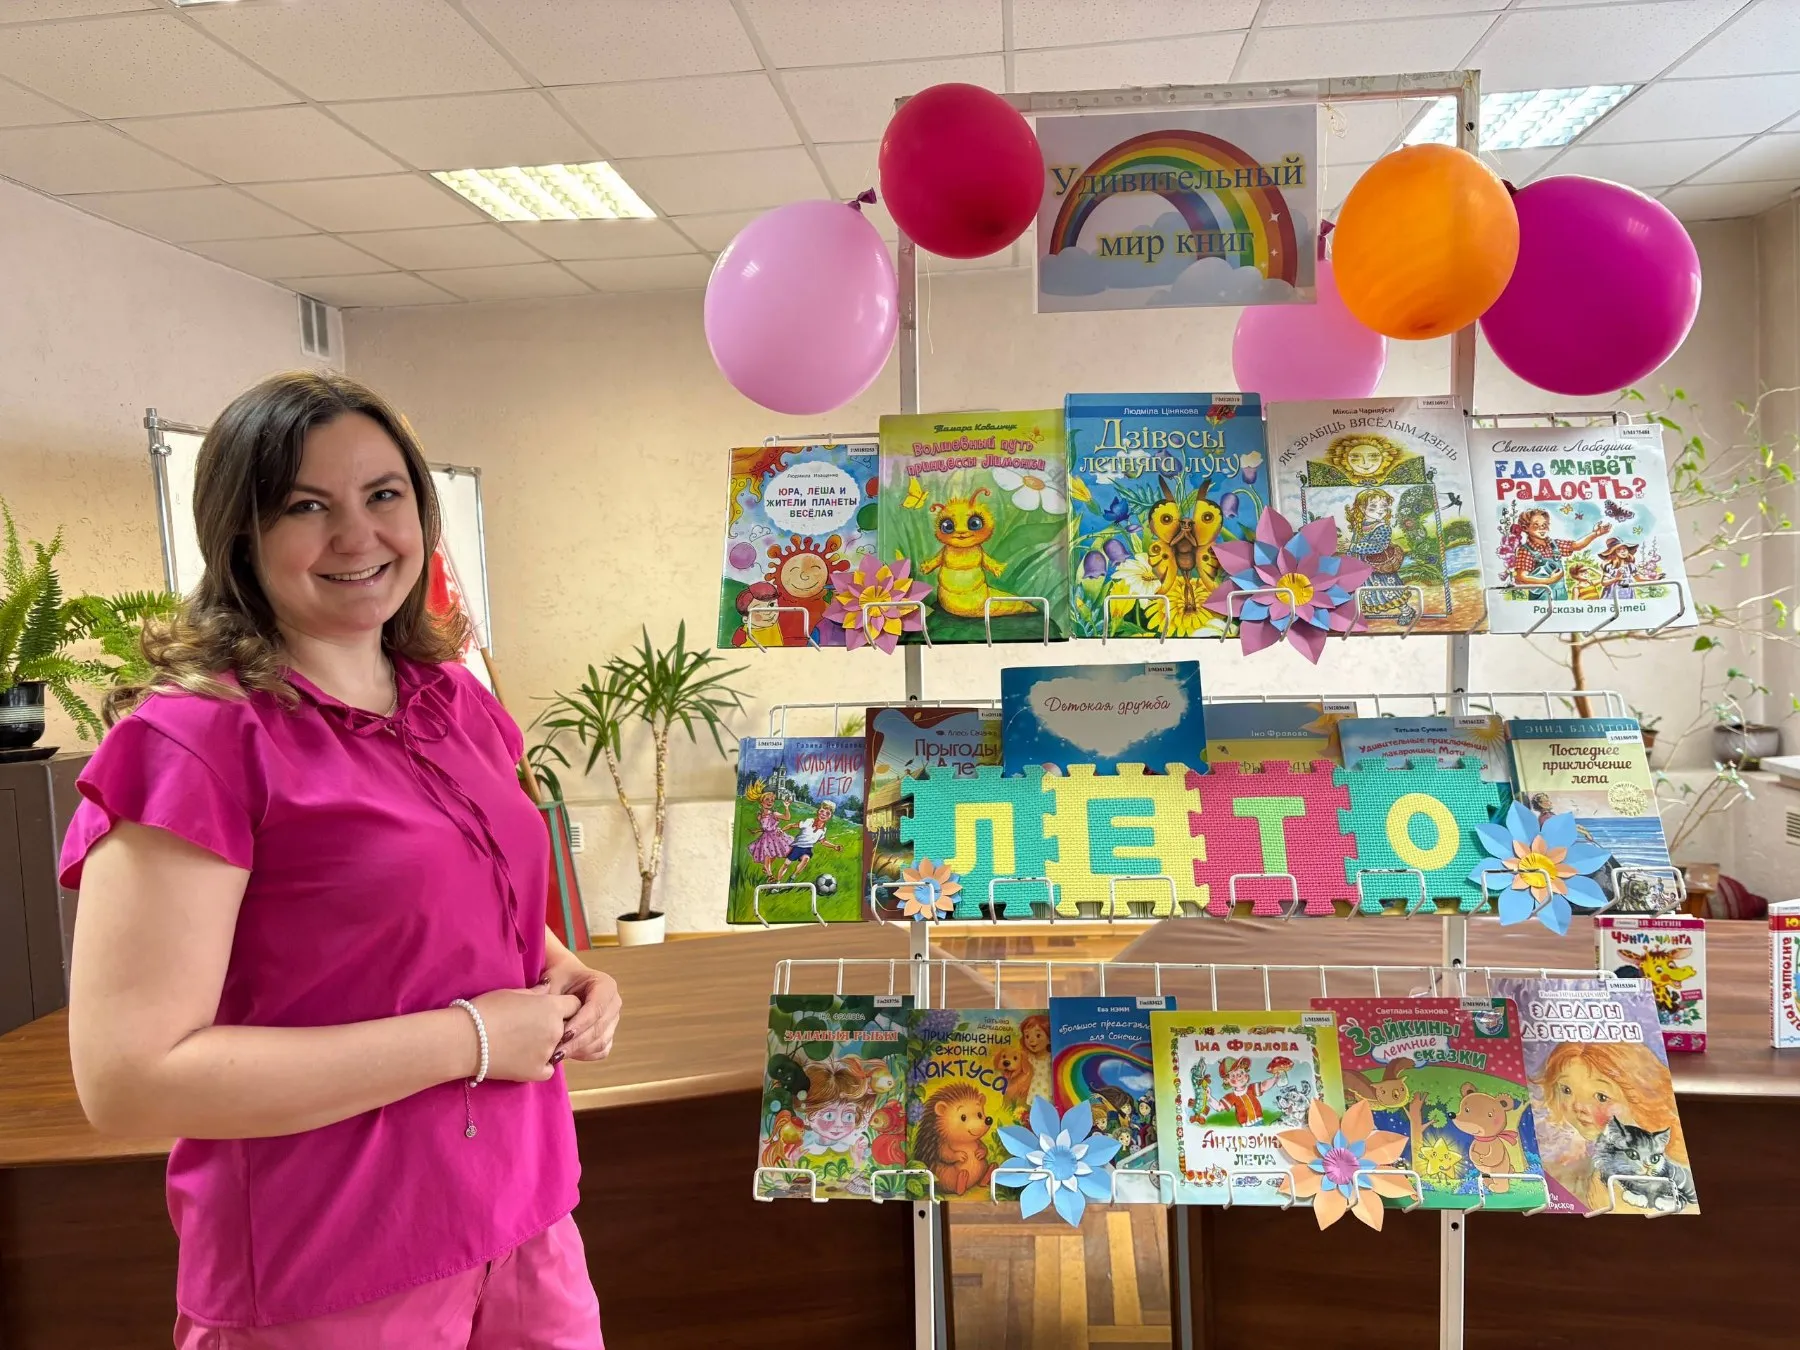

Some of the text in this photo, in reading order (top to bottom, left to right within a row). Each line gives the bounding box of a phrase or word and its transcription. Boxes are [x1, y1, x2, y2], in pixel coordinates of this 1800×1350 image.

[1050, 156, 1304, 199] Удивительный
[1100, 231, 1255, 264] мир книг
[1123, 407, 1159, 416] Людміла
[1094, 418, 1225, 453] Дзівосы
[1279, 417, 1458, 467] ЯК ЗРАБІЦЬ ВЯСЁЛЫМ ДЗЕНЬ
[912, 435, 1035, 457] Волшебный путь
[1492, 439, 1558, 453] Светлана
[906, 456, 977, 478] принцессы
[1079, 453, 1241, 478] летняга лугу
[778, 487, 803, 496] ЮРА,
[807, 485, 835, 495] ЛЁША
[766, 497, 858, 507] ЖИТЕЛИ ПЛАНЕТЫ
[789, 507, 833, 518] ВЕСЁЛАЯ
[1587, 604, 1606, 613] для
[1044, 695, 1171, 714] Детская дружба
[914, 738, 998, 761] Прыгоды
[1358, 738, 1425, 753] Удивительные
[1549, 743, 1620, 761] Последнее
[794, 750, 863, 774] КОЛЬКИНО
[1542, 759, 1632, 775] приключение
[817, 776, 853, 797] ЛЕТО
[1571, 773, 1609, 784] лета
[944, 792, 1460, 874] ЛЕТО
[1375, 1007, 1413, 1015] Светлана
[1530, 1002, 1623, 1020] ЗАБАВЫ
[1089, 1033, 1105, 1041] для
[1346, 1018, 1461, 1057] Зайкины
[1521, 1023, 1643, 1041] ДЗЕТВАРЫ
[936, 1045, 987, 1056] ежонка
[1382, 1036, 1437, 1059] летние
[1413, 1047, 1487, 1070] сказки
[913, 1059, 1009, 1095] Кактуса
[1201, 1129, 1283, 1152] Андрэйк
[1233, 1153, 1276, 1166] ЛЕТА
